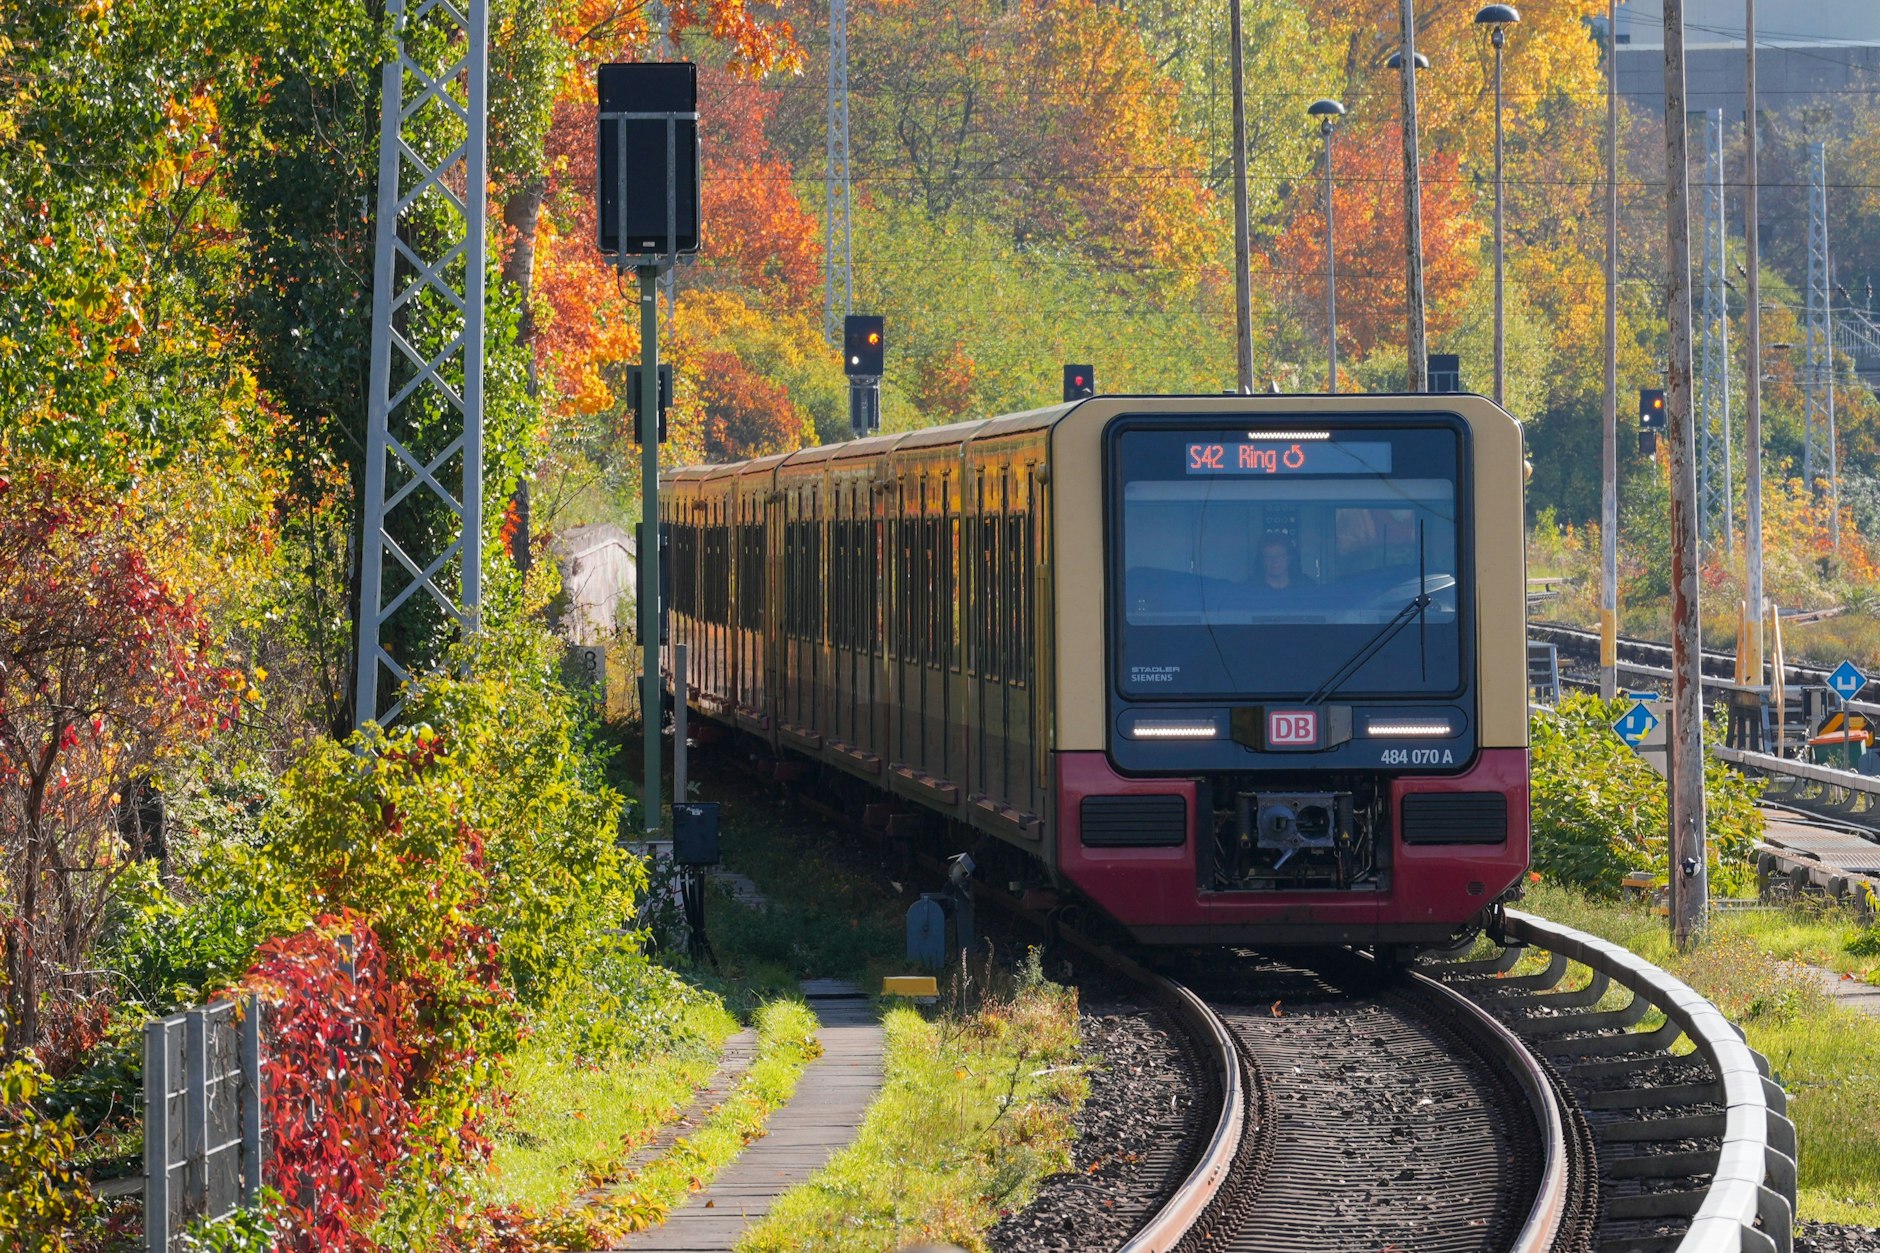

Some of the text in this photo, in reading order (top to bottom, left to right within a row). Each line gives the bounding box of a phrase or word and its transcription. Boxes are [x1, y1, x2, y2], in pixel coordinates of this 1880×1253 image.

[1190, 445, 1277, 473] S42 Ring
[1131, 673, 1173, 682] SIEMENS
[1275, 717, 1311, 739] DB
[1380, 749, 1454, 764] 484 070 A
